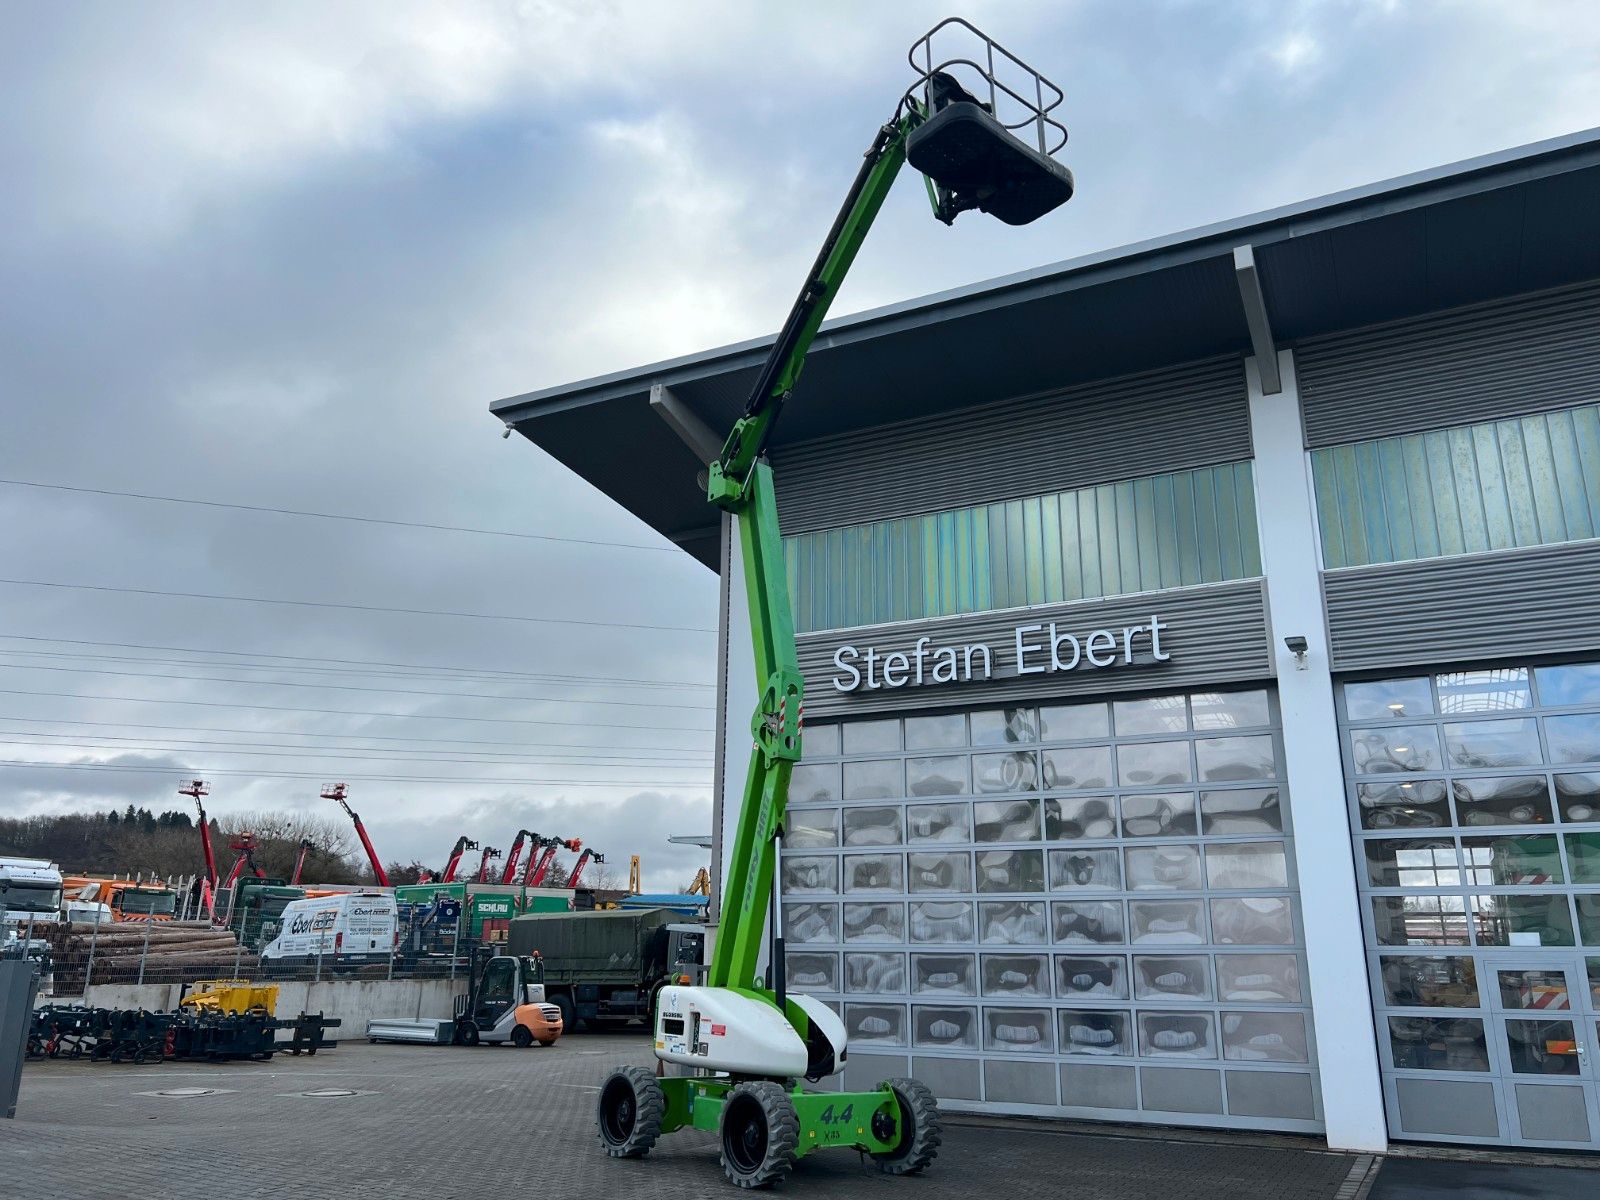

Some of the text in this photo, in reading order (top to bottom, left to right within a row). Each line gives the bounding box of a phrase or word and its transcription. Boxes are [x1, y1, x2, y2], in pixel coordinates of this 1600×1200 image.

[832, 615, 1170, 693] Stefan Ebert
[820, 1103, 854, 1125] 4x4
